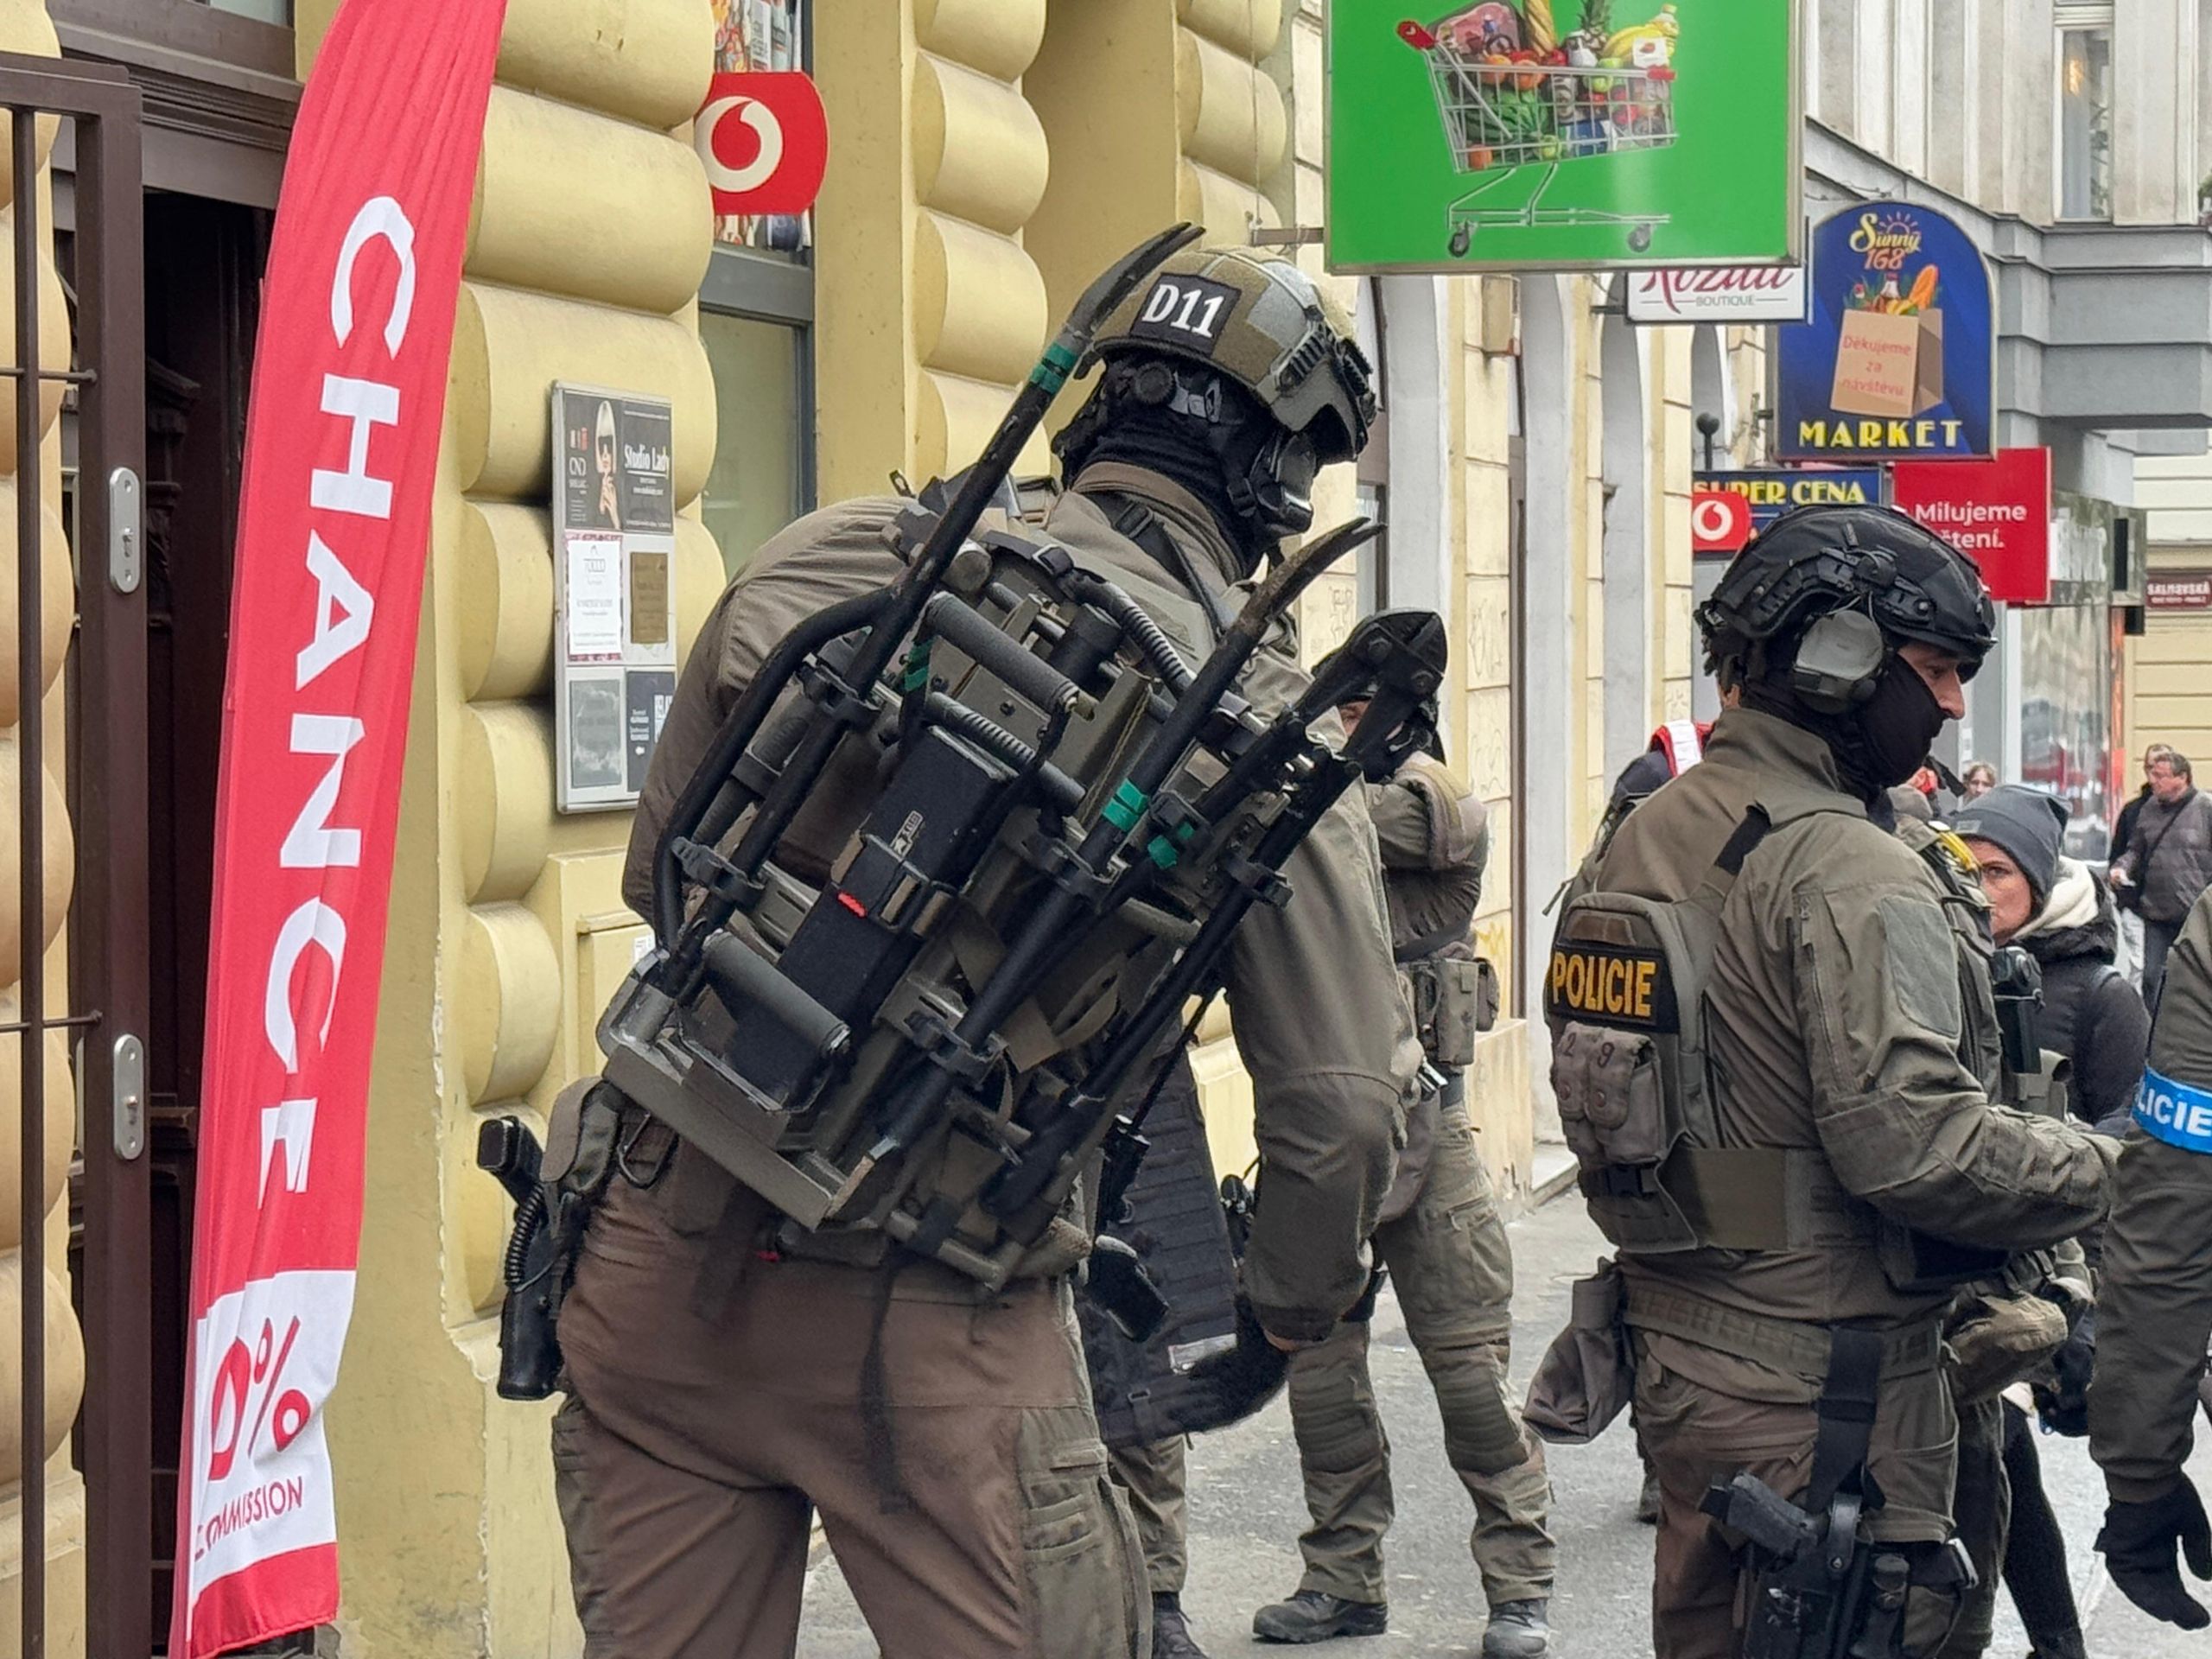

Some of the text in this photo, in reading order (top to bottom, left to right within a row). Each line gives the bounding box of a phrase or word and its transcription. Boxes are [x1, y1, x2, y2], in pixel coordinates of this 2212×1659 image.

[1850, 213, 1922, 253] Sunny
[1864, 247, 1906, 270] 168
[1141, 283, 1224, 338] D11
[1696, 295, 1755, 307] BOUTIQUE
[1866, 361, 1882, 372] za
[1798, 419, 1962, 448] MARKET
[1791, 480, 1867, 505] CENA
[1915, 500, 2027, 526] Milujeme
[1552, 951, 1656, 1017] POLICIE
